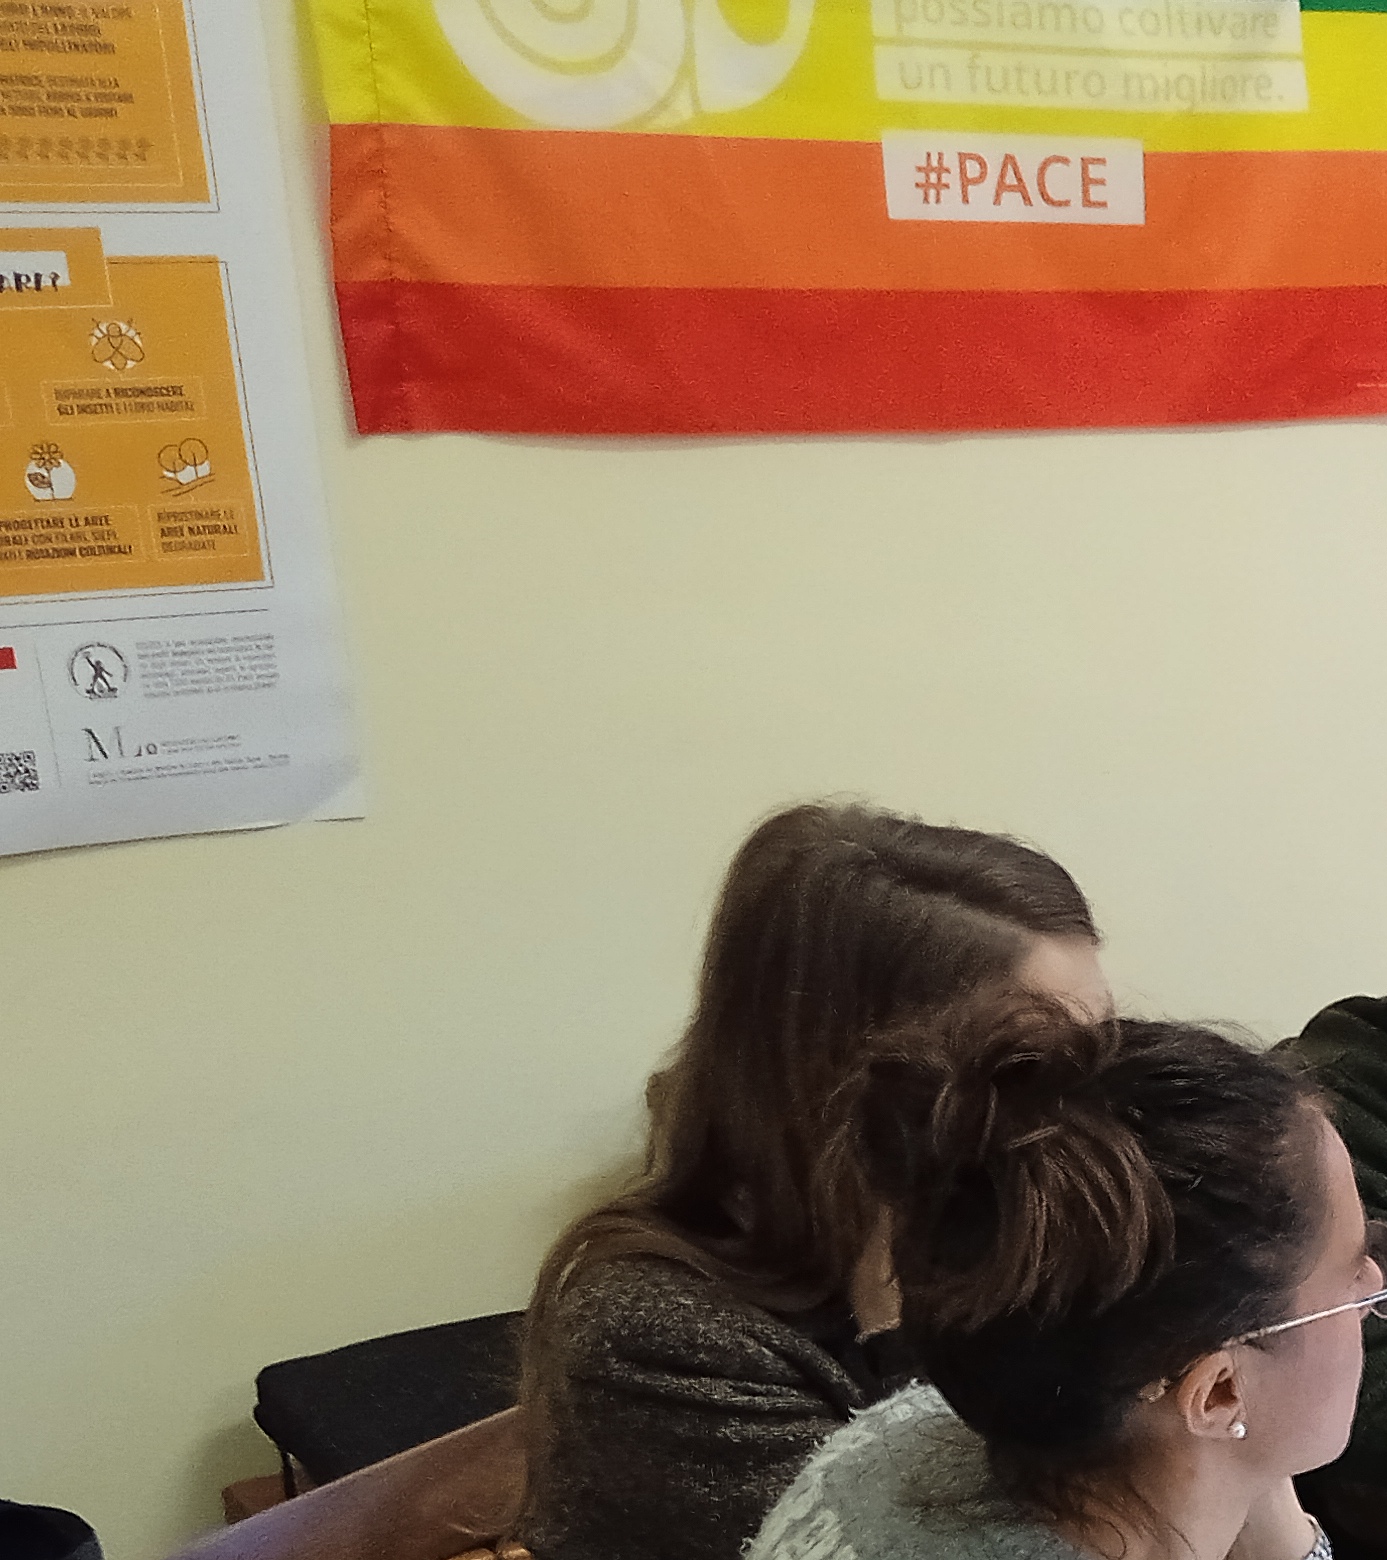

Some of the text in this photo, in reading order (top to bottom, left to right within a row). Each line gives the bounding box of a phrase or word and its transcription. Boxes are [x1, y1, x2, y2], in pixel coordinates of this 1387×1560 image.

[894, 0, 1278, 39] possiamo coltivare
[899, 51, 1284, 116] un futuro migliore.
[914, 150, 1110, 208] #PACE
[188, 524, 238, 536] NATURALI
